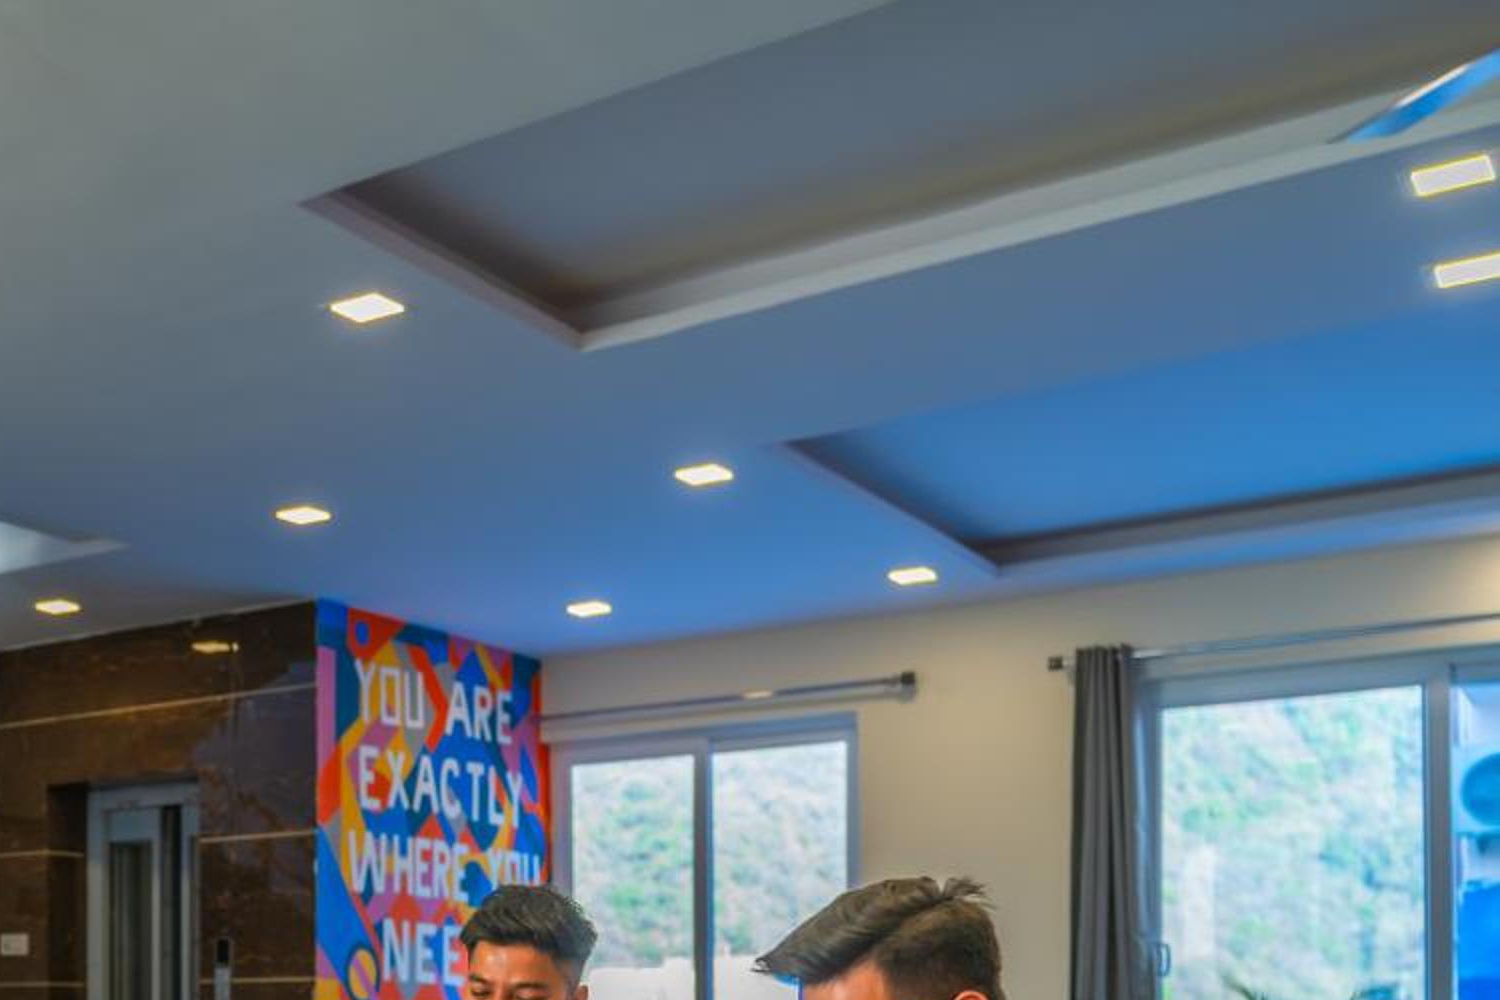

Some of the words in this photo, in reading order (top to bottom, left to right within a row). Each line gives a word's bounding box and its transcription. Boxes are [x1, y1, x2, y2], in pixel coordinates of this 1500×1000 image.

[354, 658, 425, 729] YOU
[445, 681, 513, 745] ARE
[358, 745, 524, 830] EXACTLY
[348, 829, 469, 903] WHERE
[383, 917, 466, 987] NEE
